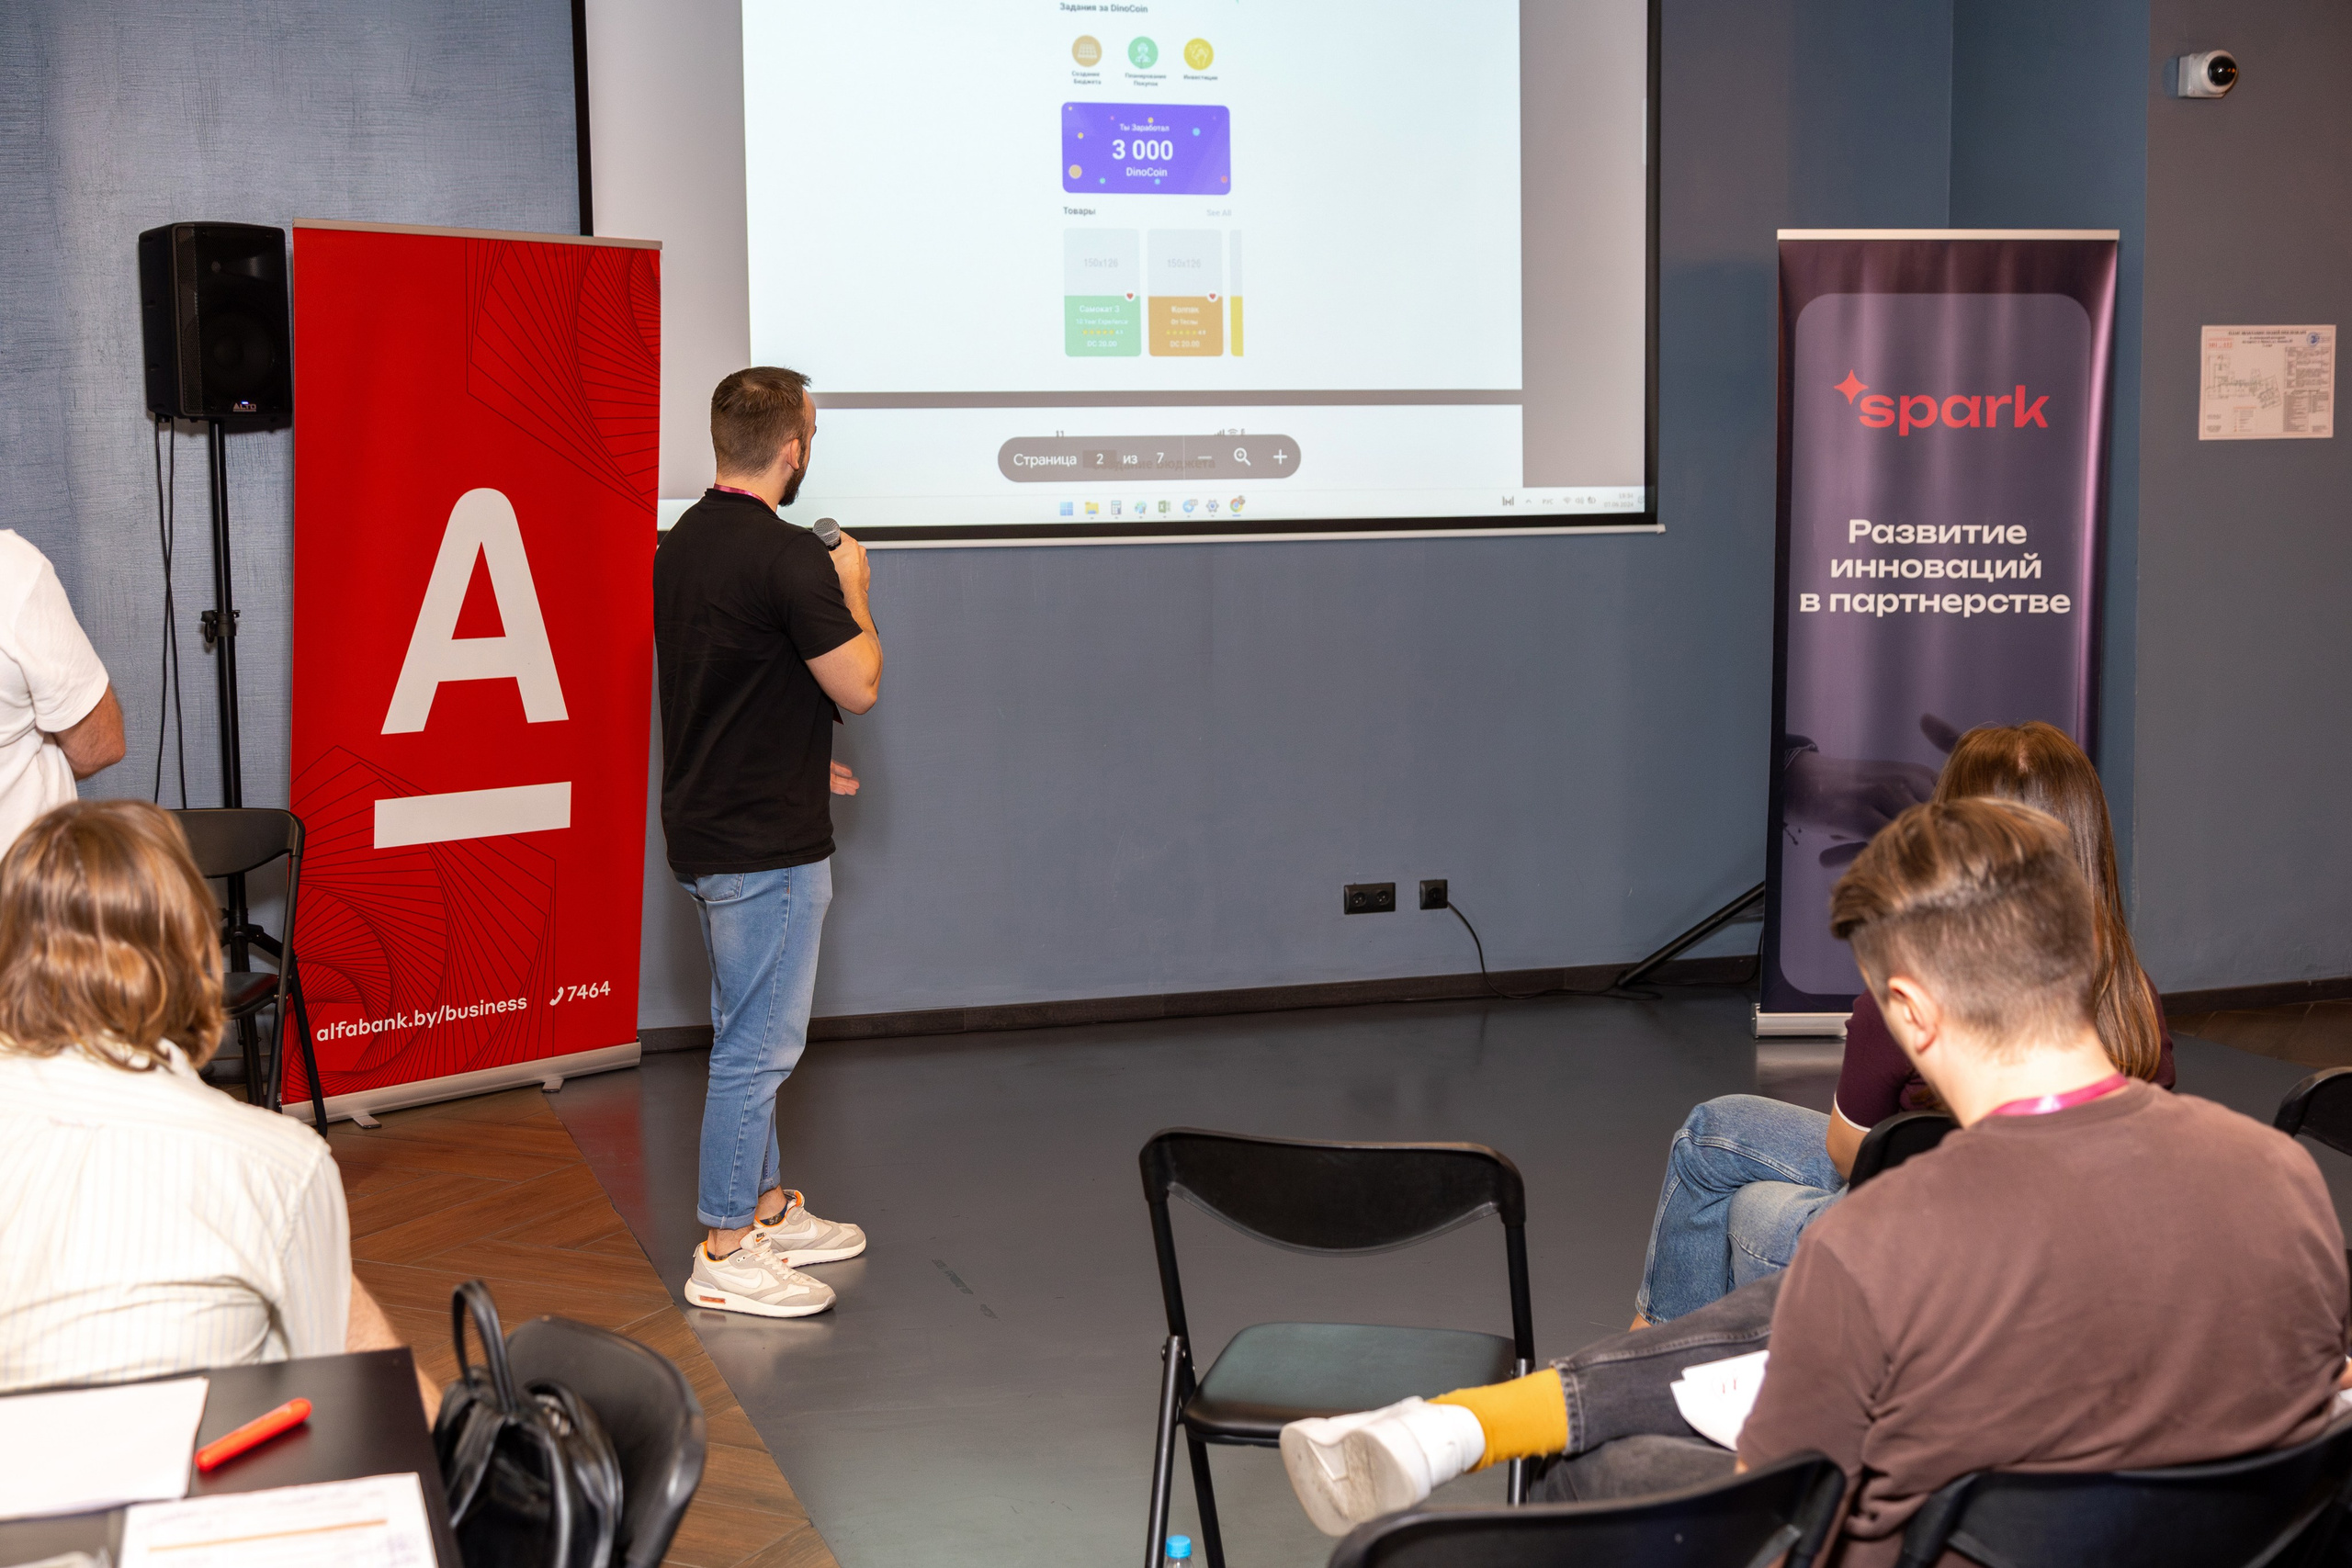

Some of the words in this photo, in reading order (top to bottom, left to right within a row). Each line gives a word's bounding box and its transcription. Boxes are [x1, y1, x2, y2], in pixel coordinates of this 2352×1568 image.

[1060, 3, 1097, 13] Задания
[1111, 4, 1148, 14] DinoCoin
[1131, 123, 1170, 132] Заработал
[1112, 139, 1126, 160] 3
[1132, 139, 1174, 161] 000
[1125, 167, 1168, 177] DinoCoin
[1063, 206, 1096, 216] Товары
[1206, 209, 1220, 217] See
[1221, 209, 1232, 217] All
[1083, 257, 1118, 268] 150x126
[1079, 305, 1113, 313] Самокат
[1859, 385, 2050, 437] spark
[1012, 452, 1078, 468] Страница
[1095, 453, 1104, 465] 2
[1123, 454, 1138, 465] из
[1156, 452, 1165, 465] 7
[1849, 519, 2027, 545] Развитие
[1831, 552, 2041, 582] инноваций
[1800, 593, 1821, 613] в
[1829, 593, 2072, 617] партнерстве
[316, 996, 528, 1042] alfabank.by/business
[567, 980, 612, 1002] 7464
